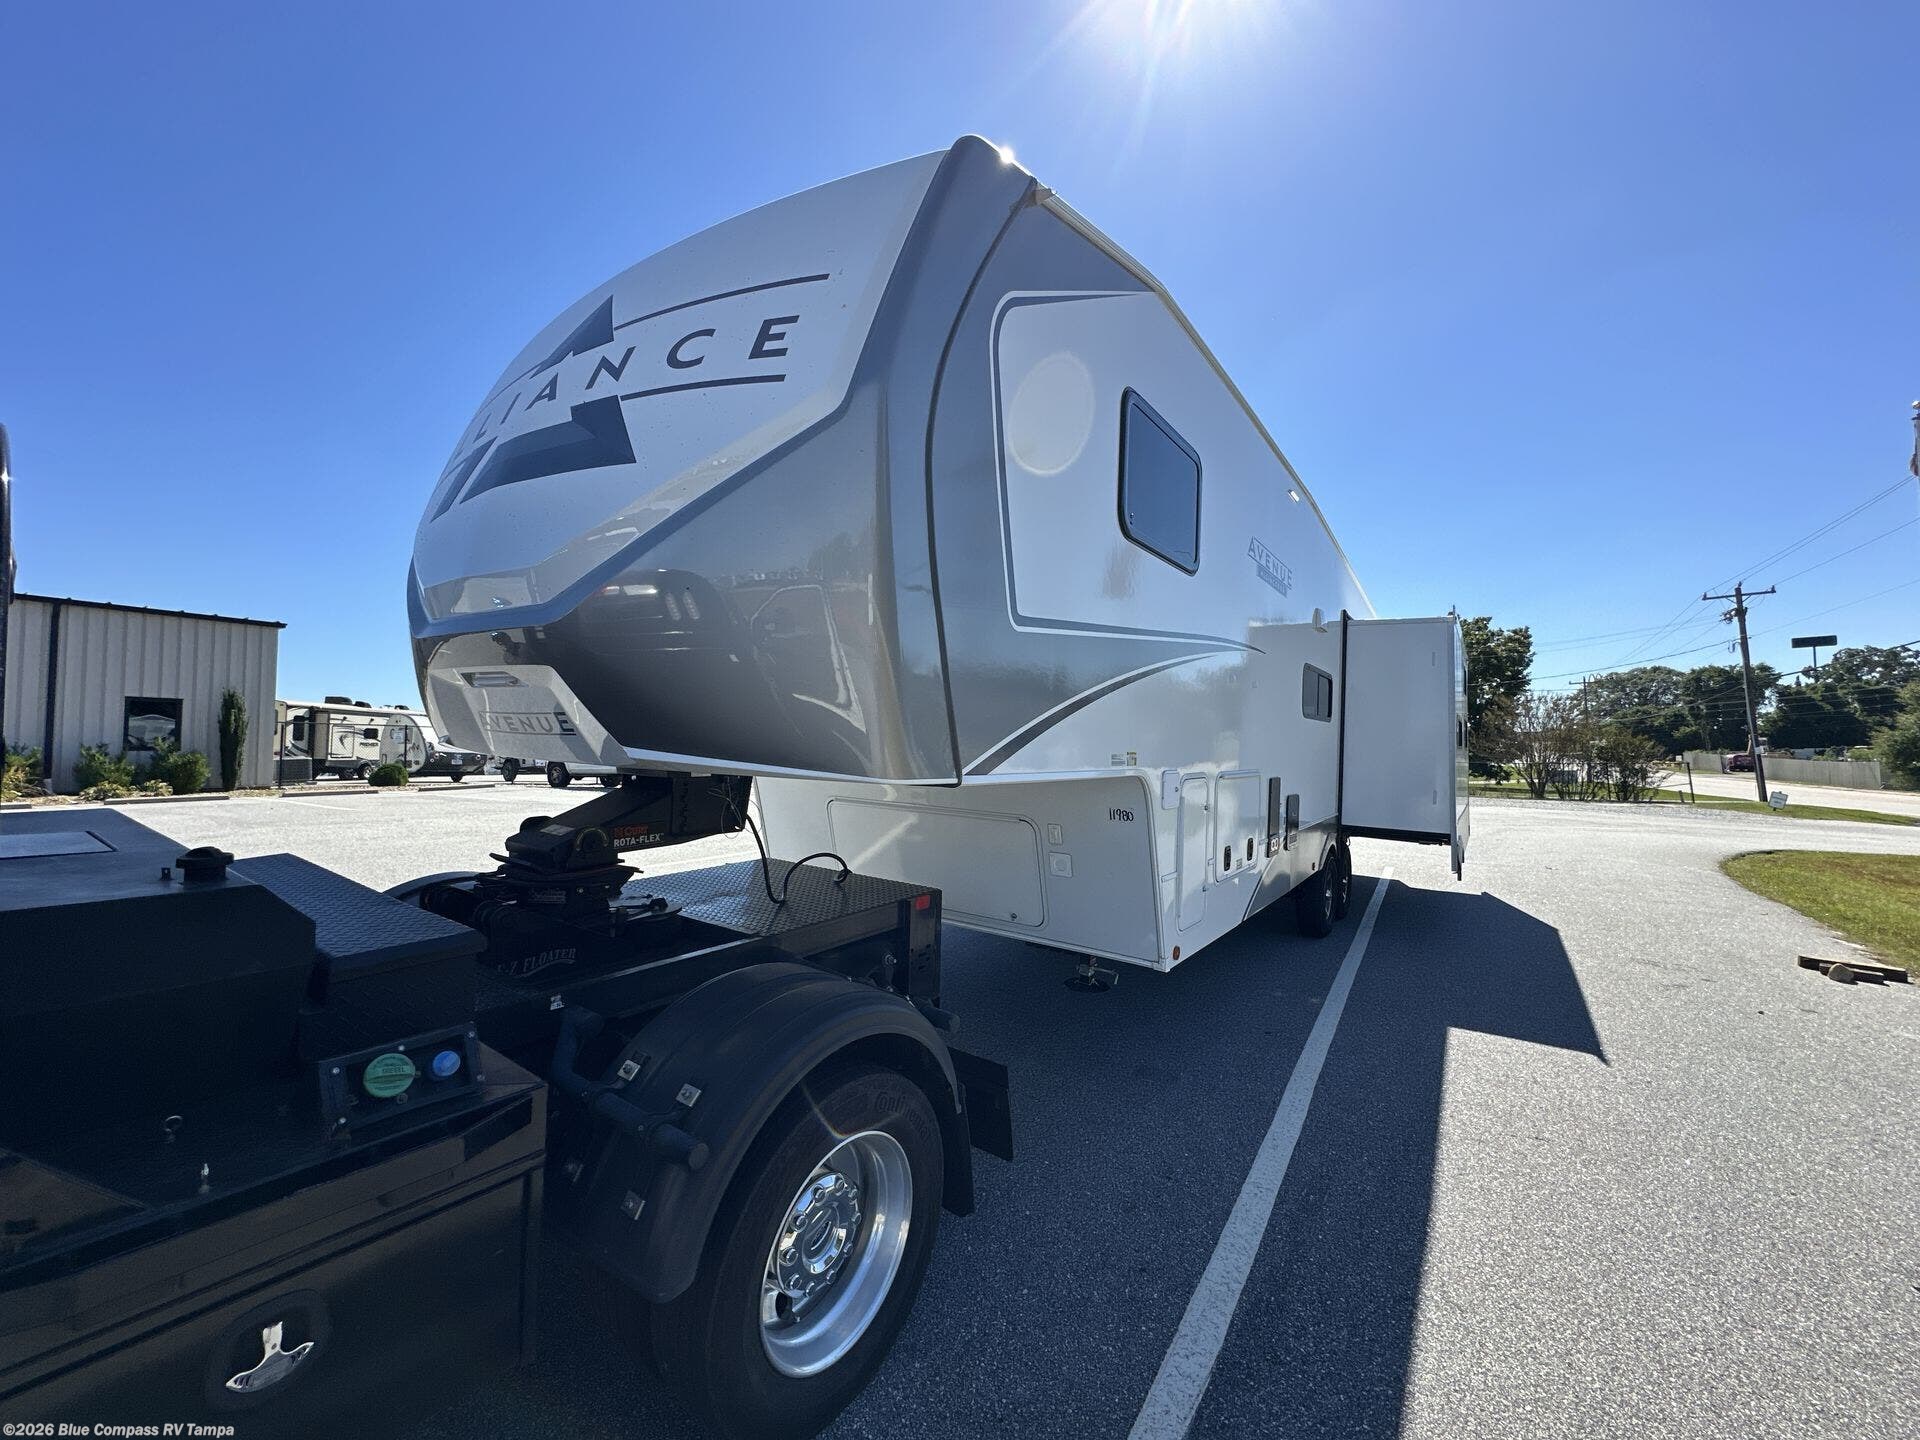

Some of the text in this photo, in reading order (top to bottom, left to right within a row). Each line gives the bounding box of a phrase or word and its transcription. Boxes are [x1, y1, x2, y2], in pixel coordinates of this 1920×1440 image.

[1248, 536, 1292, 587] AVENUE
[1109, 808, 1134, 822] 11980
[523, 948, 576, 972] FLOATER
